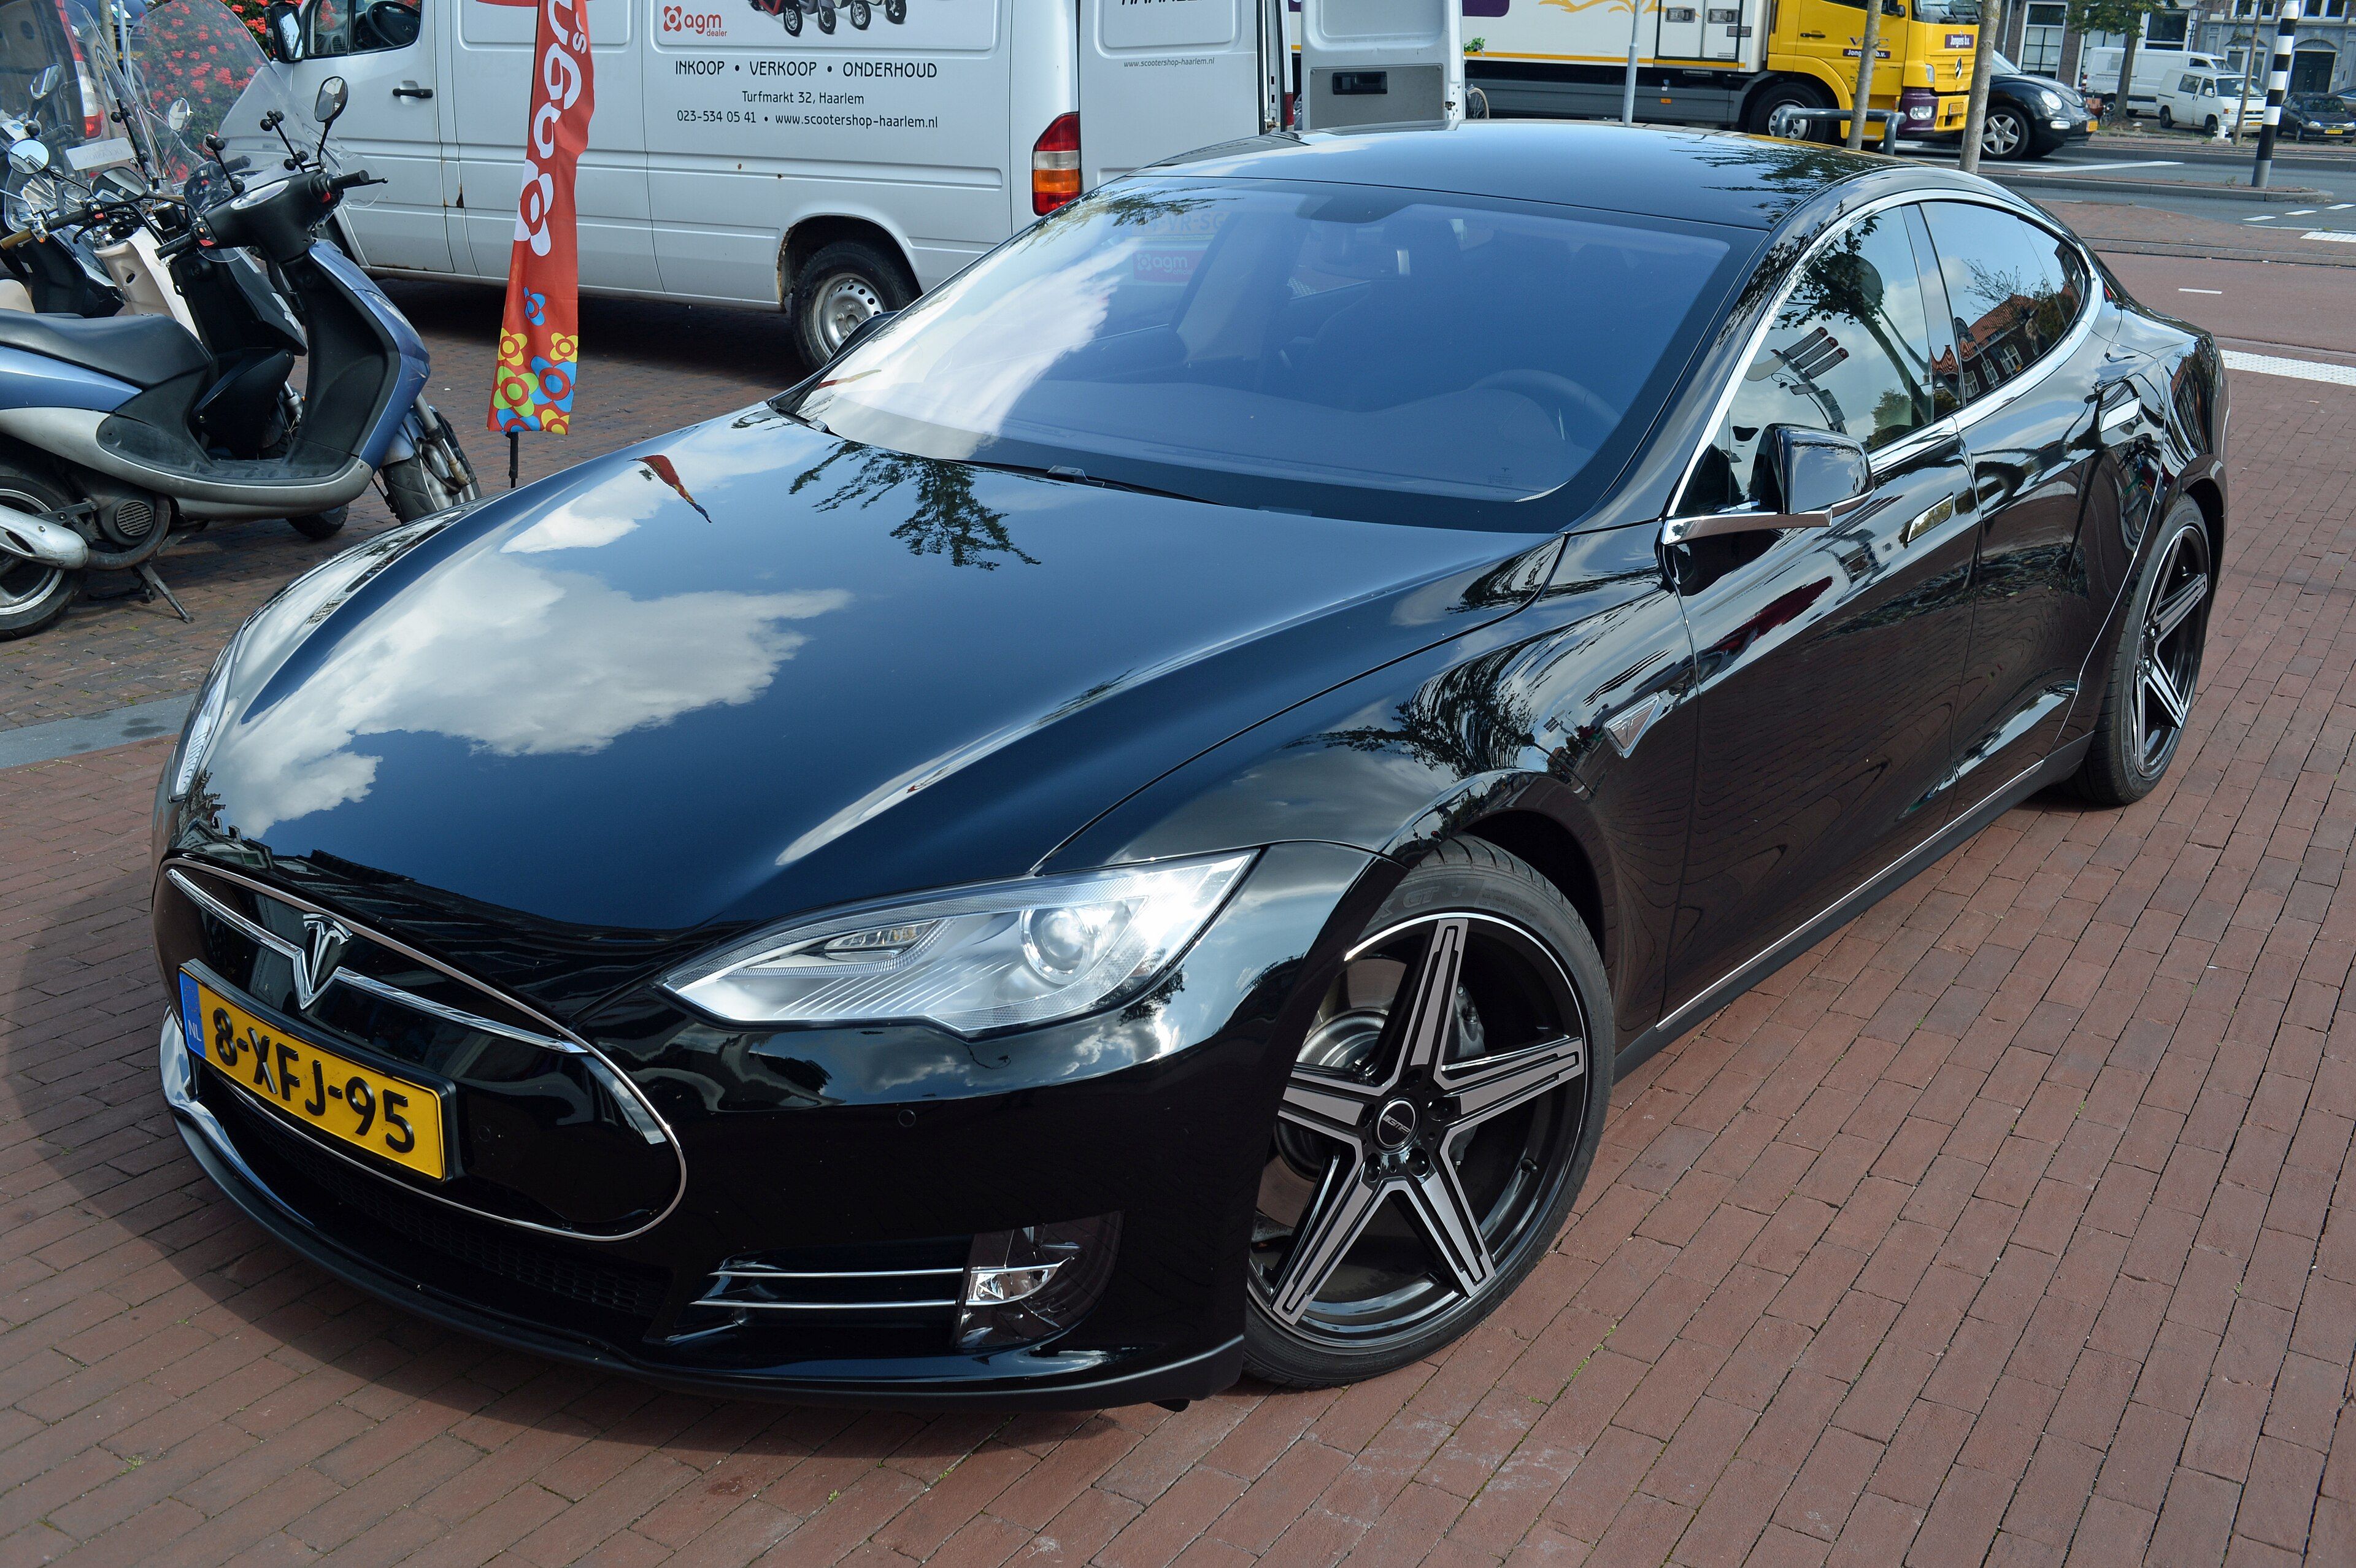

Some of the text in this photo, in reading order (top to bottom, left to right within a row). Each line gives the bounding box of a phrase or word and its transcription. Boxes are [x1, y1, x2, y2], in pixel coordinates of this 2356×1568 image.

[684, 13, 722, 35] agm
[706, 29, 728, 37] dealer
[676, 60, 937, 78] INKOOP VERKOOP ONDERHOUD
[1123, 57, 1215, 68] www.scootershop-haarlem.nl
[742, 90, 864, 104] Turfmarkt 32, Haarlem
[677, 110, 938, 129] 023-534 05 41 www.scootershop-haarlem.nl
[1153, 256, 1188, 272] agm
[188, 1022, 202, 1042] NL
[212, 1007, 415, 1153] 8-XFJ-95
